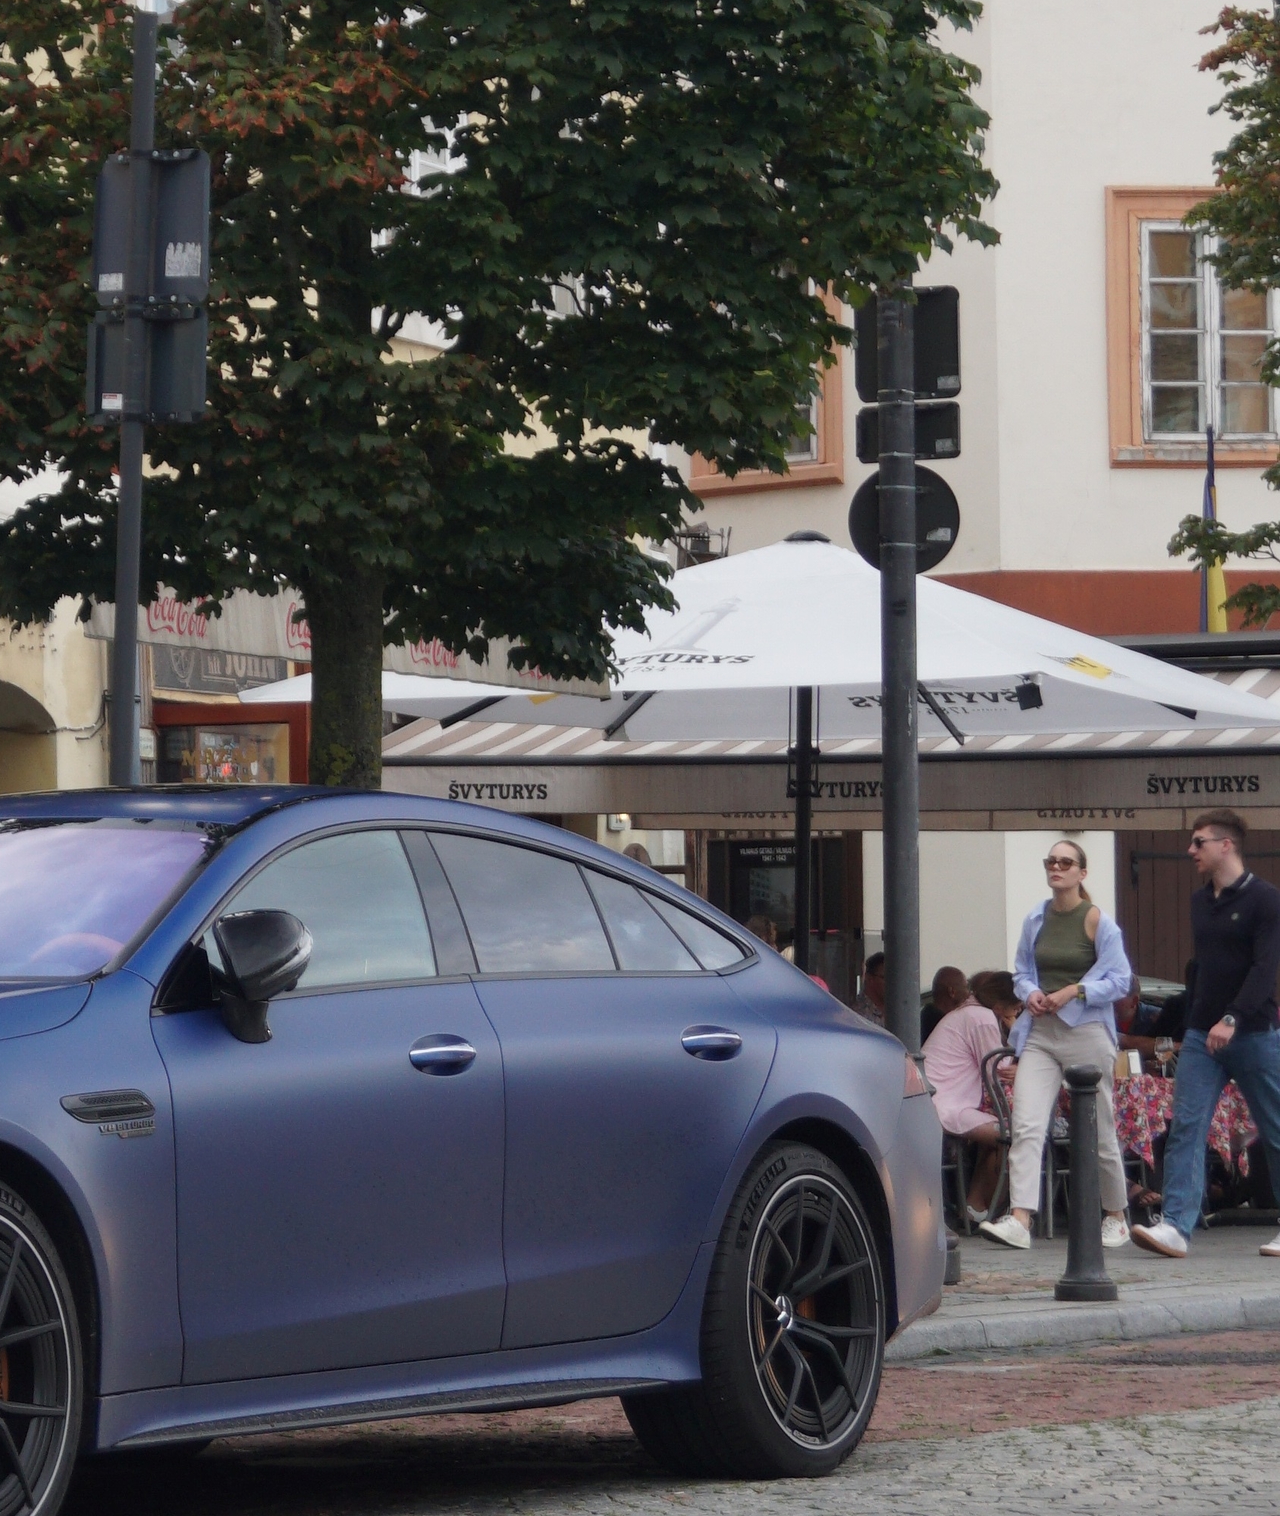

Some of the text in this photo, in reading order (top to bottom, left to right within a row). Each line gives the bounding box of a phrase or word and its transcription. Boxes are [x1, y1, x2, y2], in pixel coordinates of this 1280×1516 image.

[448, 780, 548, 800] ŠVYTURYS
[1146, 773, 1260, 794] ŠVYTURYS
[742, 1157, 785, 1227] MICHELIN
